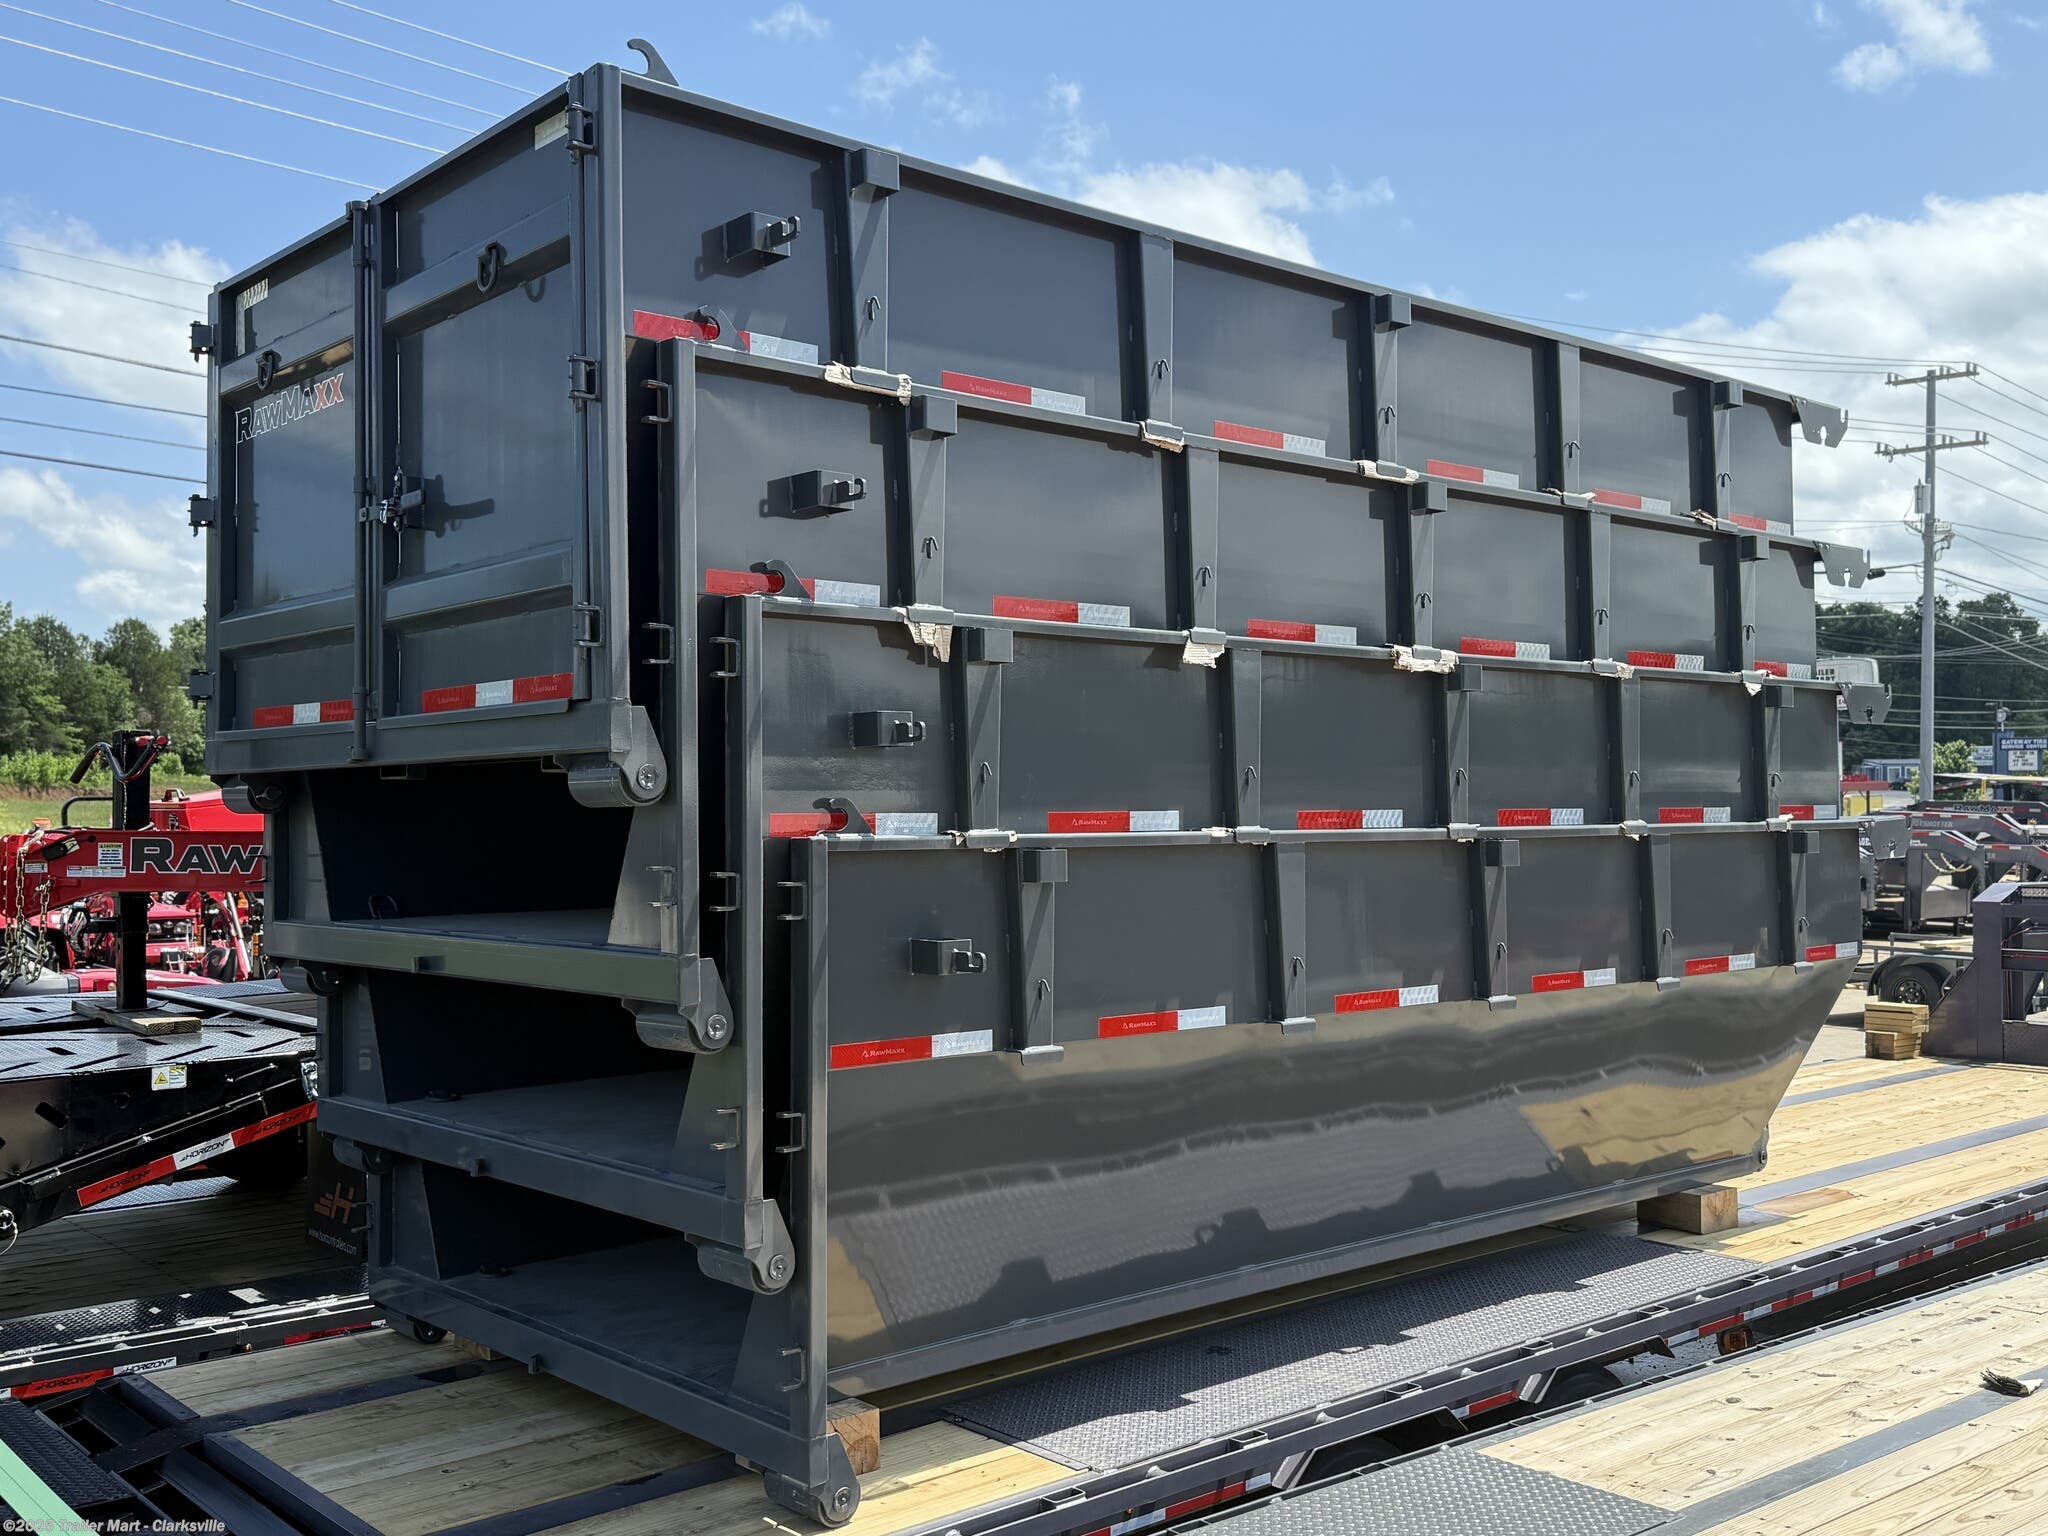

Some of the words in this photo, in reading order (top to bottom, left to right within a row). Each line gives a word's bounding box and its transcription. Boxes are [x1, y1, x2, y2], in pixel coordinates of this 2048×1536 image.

[235, 373, 344, 444] RAWMAXX
[257, 1113, 301, 1134] HORIZON
[181, 1138, 230, 1161] HORIZON
[103, 1169, 152, 1192] HORIZON
[124, 1358, 175, 1374] HORIZON
[37, 1374, 93, 1391] HORIZON
